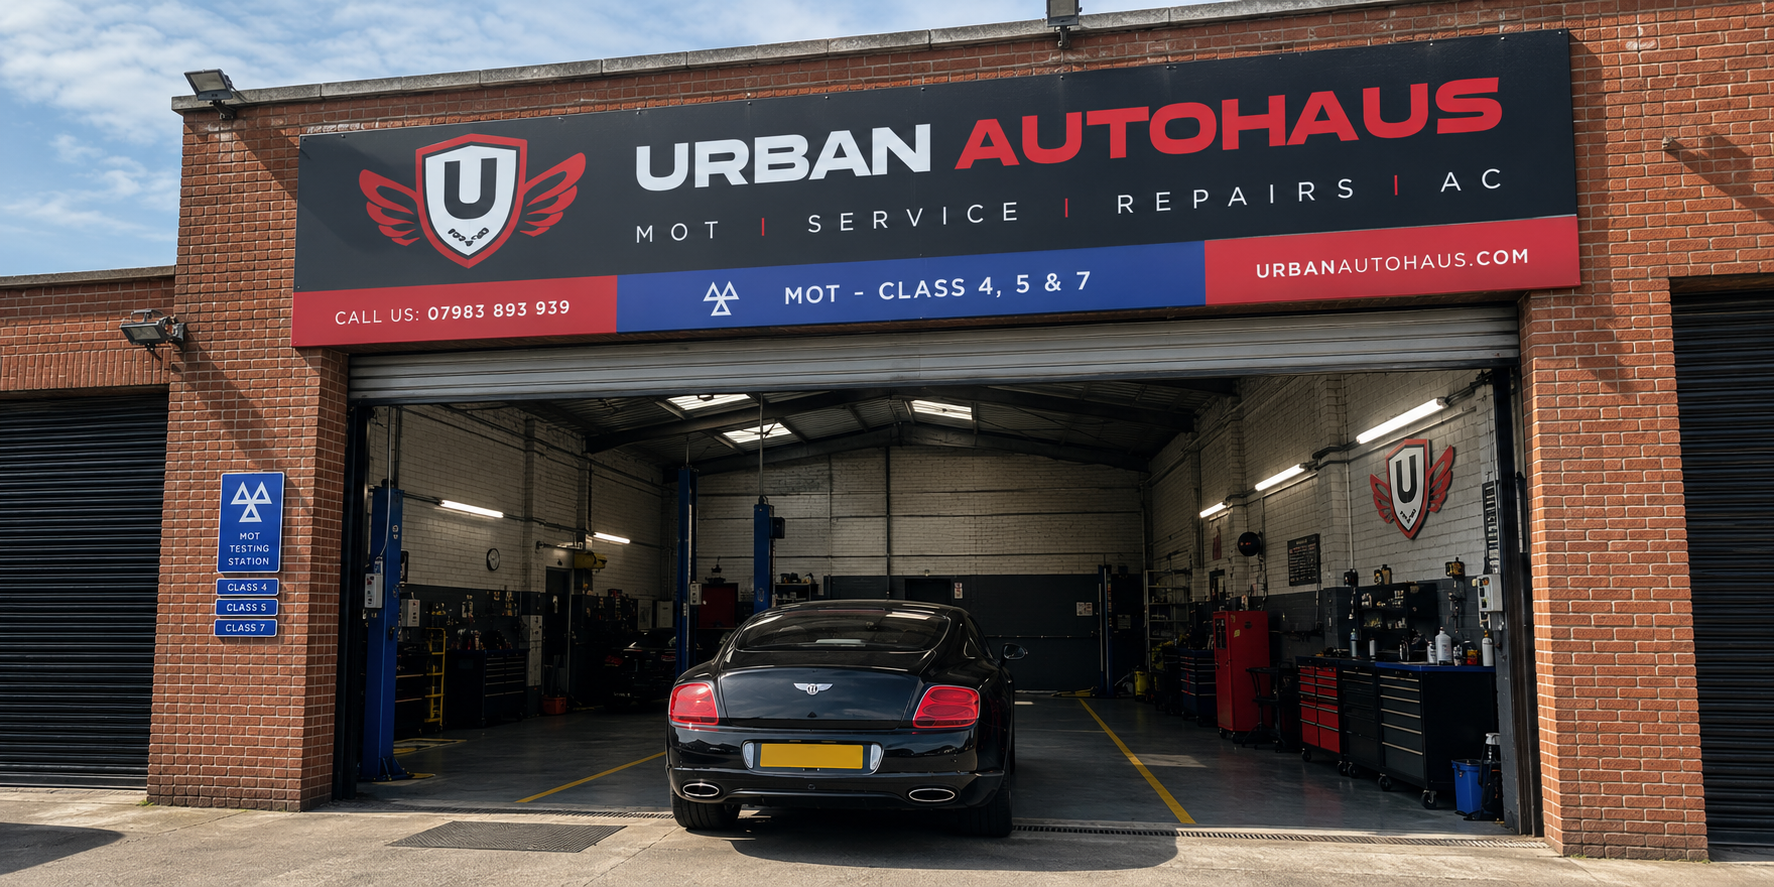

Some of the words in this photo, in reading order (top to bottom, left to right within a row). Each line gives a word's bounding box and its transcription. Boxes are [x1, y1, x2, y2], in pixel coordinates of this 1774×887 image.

[635, 123, 931, 192] URBAN
[954, 76, 1503, 170] AUTOHAUS
[636, 220, 720, 244] MOT
[808, 201, 1019, 234] SERVICE
[1117, 178, 1355, 215] REPAIRS
[1440, 168, 1502, 194] AC
[1256, 248, 1529, 279] URBANAUTOHAUS.COM
[785, 284, 840, 305] MOT
[878, 278, 967, 300] CLASS
[978, 276, 1002, 298] 4,
[1016, 274, 1031, 294] 5
[1044, 272, 1063, 292] &
[1076, 270, 1092, 290] 7
[335, 309, 383, 325] CALL
[390, 308, 420, 323] US:
[427, 304, 486, 321] 07983
[493, 302, 528, 318] 893
[535, 299, 570, 316] 939
[239, 532, 260, 540] MOT
[229, 544, 270, 553] TESTING
[228, 557, 269, 566] STATION
[227, 583, 258, 592] CLASS
[261, 583, 267, 591] 4
[226, 603, 257, 612] CLASS
[260, 603, 267, 612] 5
[225, 623, 256, 632] CLASS
[259, 623, 266, 632] 7
